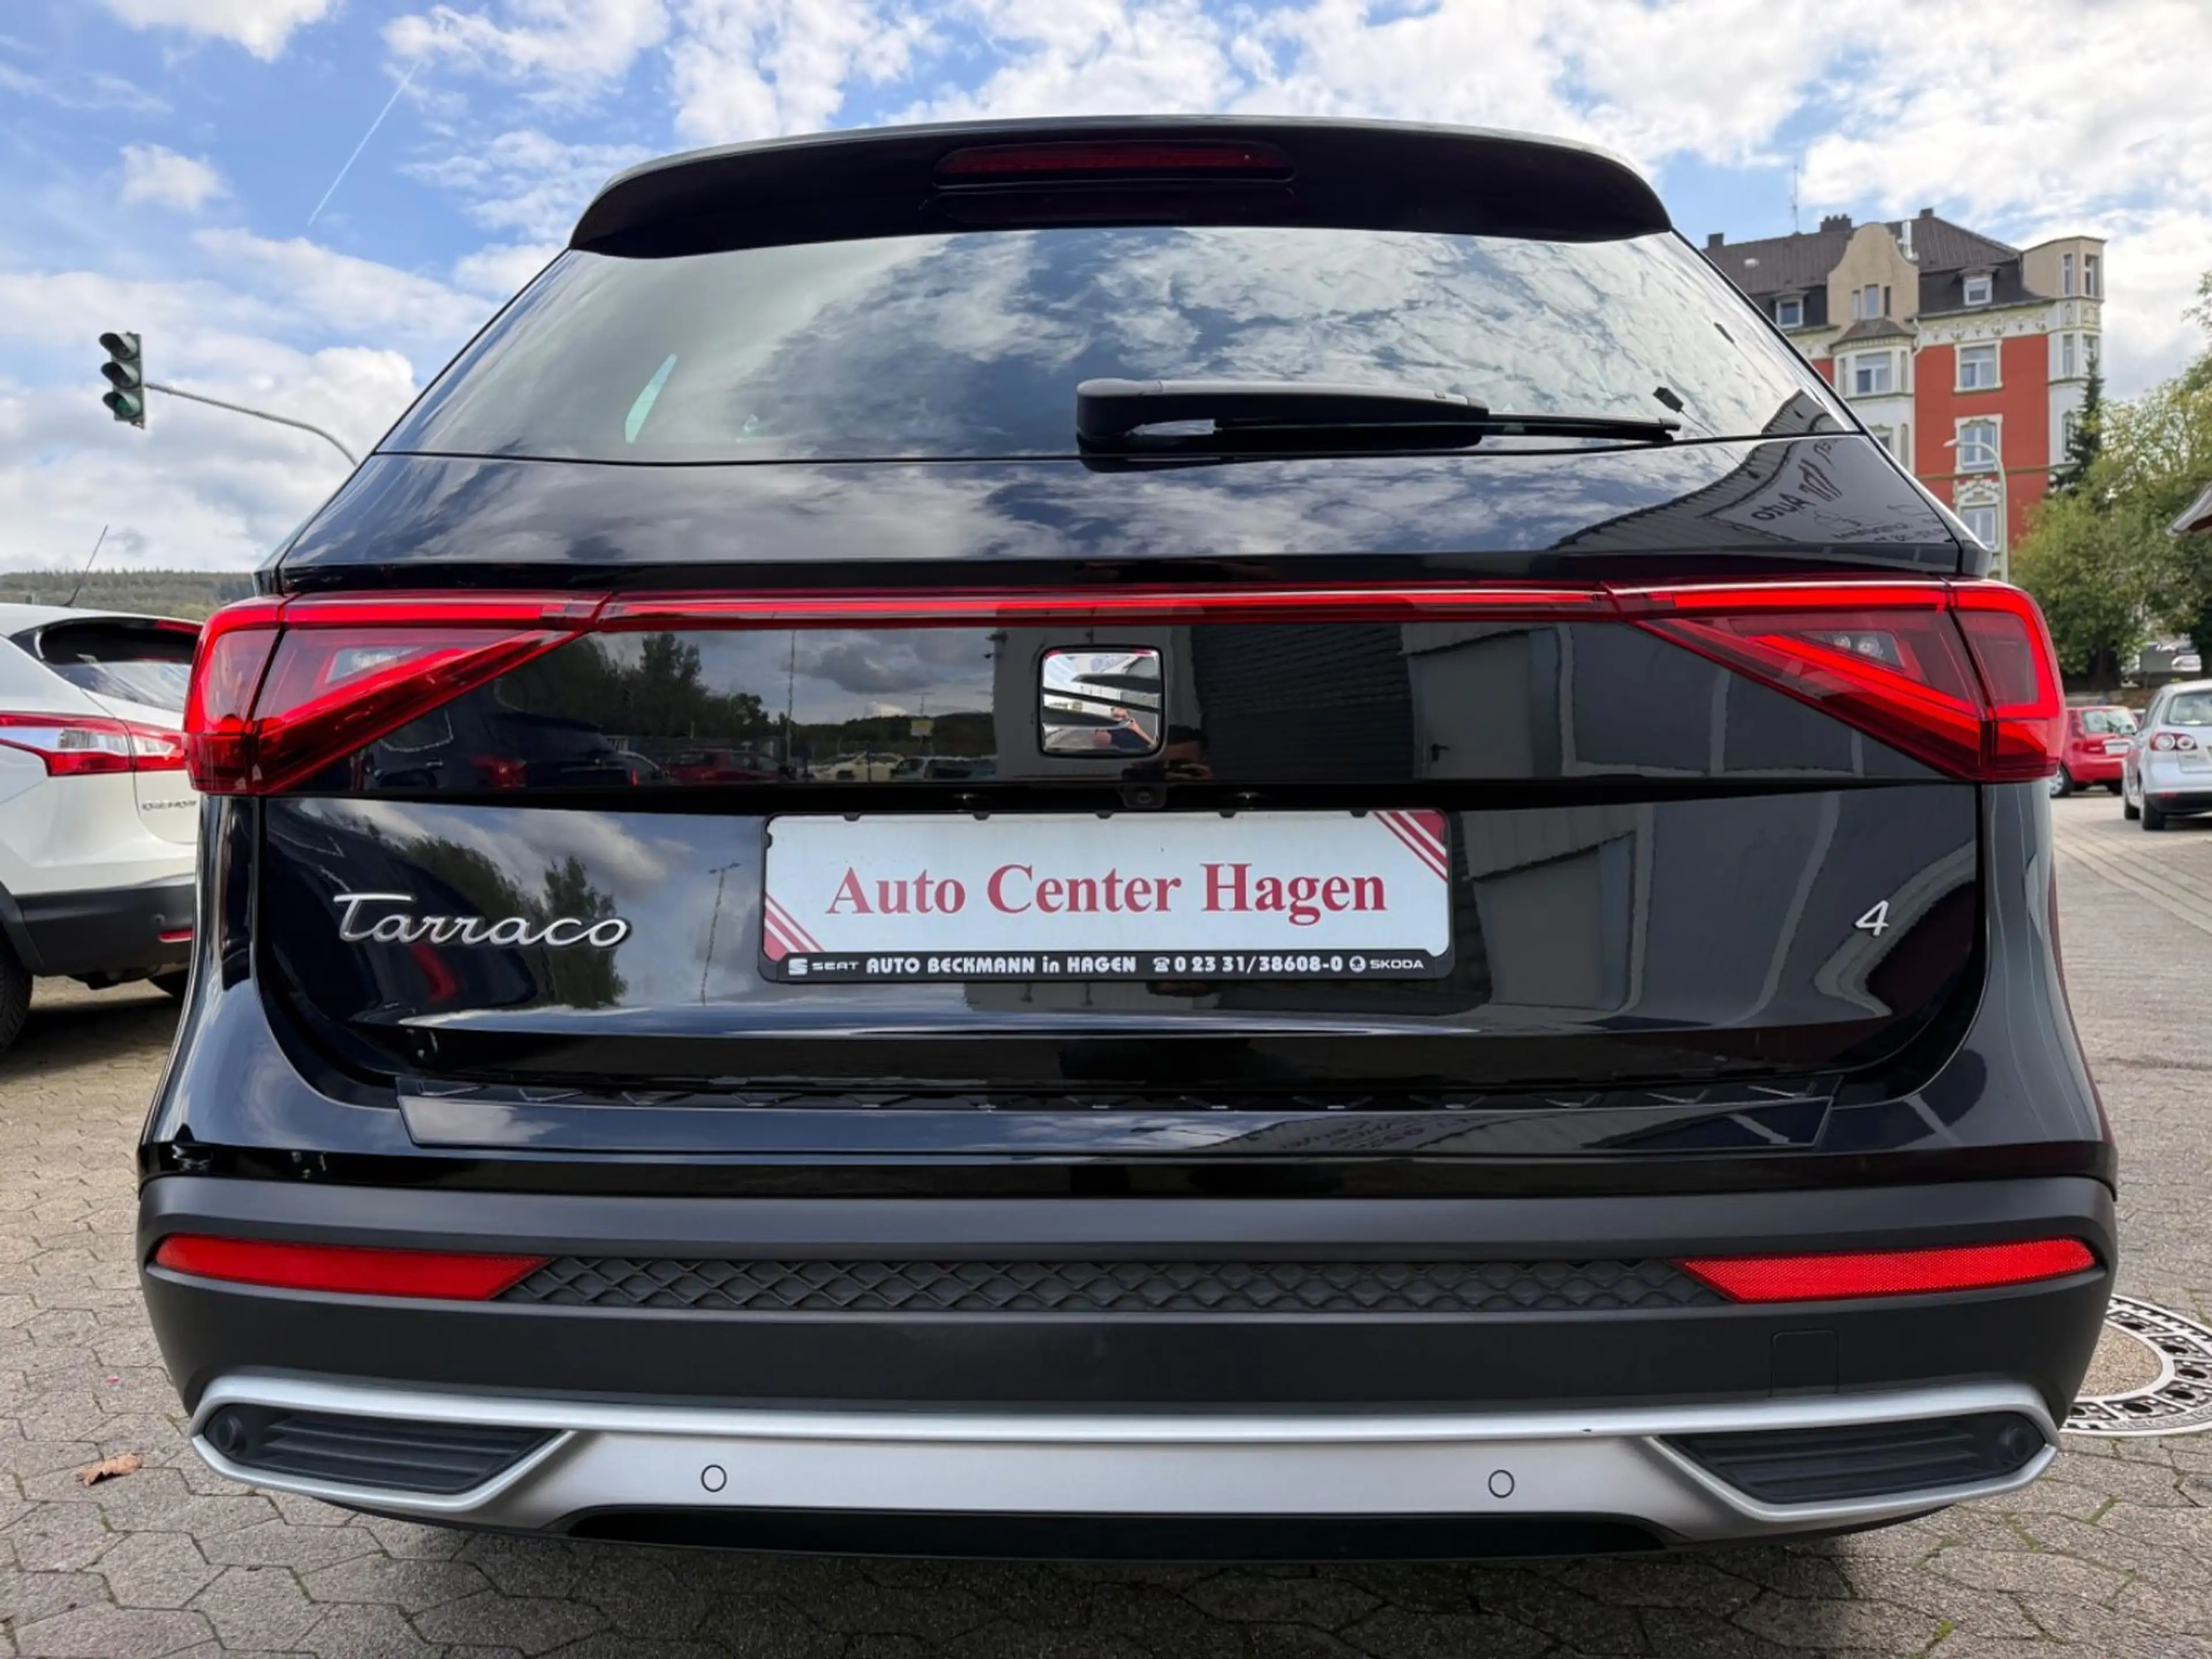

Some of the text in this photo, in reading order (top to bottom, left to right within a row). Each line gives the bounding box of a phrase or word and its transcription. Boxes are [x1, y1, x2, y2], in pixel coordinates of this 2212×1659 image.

[825, 863, 1388, 926] Auto Center Hagen
[334, 893, 630, 946] Tarraco
[1855, 900, 1889, 935] 4
[812, 961, 859, 971] SEAT
[866, 957, 921, 974] AUTO
[927, 957, 1035, 974] BECKMANN
[1042, 955, 1060, 973] in
[1067, 956, 1136, 973] HAGEN
[1370, 959, 1425, 969] SKODA
